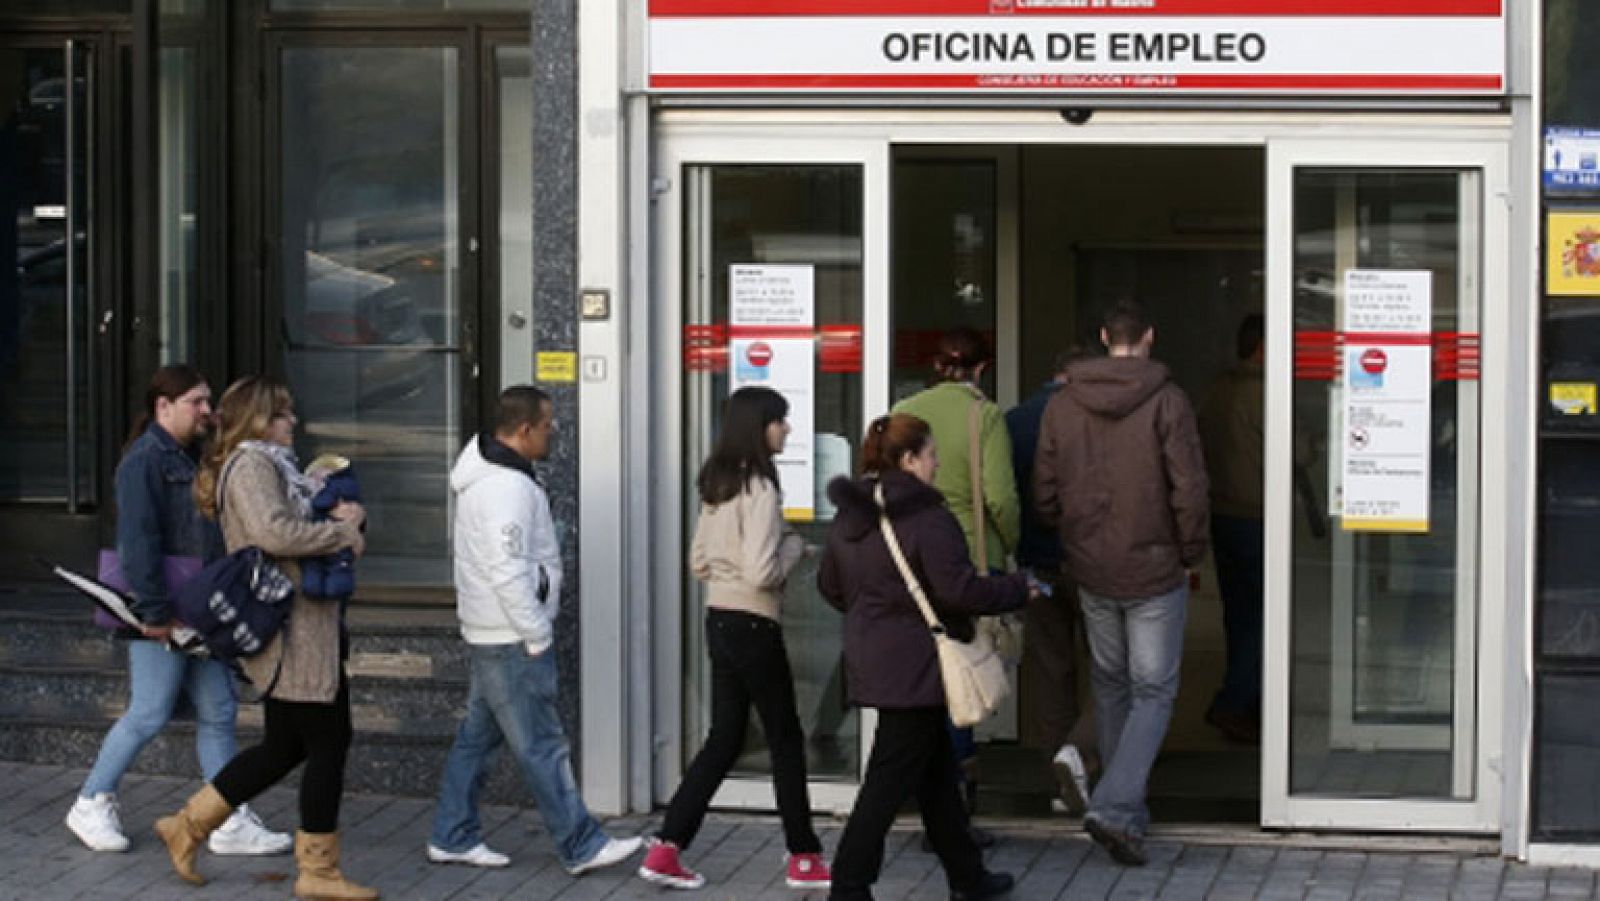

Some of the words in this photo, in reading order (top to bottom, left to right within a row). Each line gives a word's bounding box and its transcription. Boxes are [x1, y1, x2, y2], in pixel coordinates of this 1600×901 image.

[882, 32, 1034, 62] OFICINA
[1047, 33, 1096, 61] DE
[1109, 32, 1266, 62] EMPLEO
